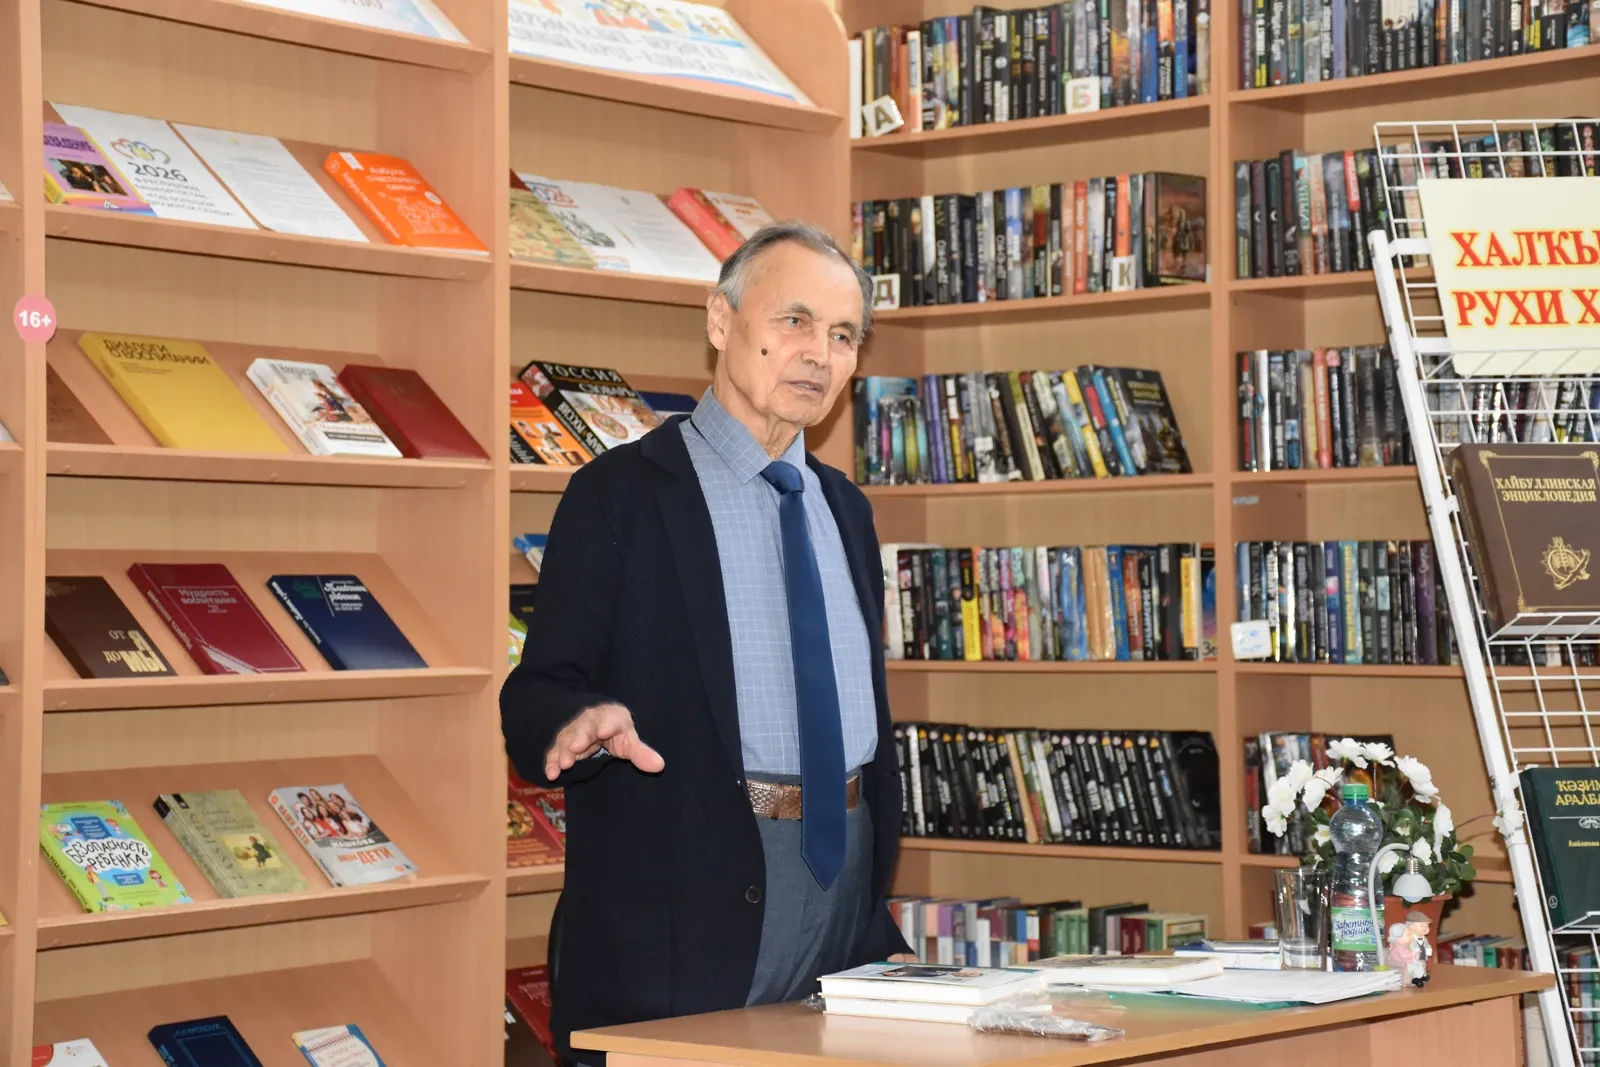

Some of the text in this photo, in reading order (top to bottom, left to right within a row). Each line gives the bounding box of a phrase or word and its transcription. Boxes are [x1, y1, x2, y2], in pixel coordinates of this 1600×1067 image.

[1071, 84, 1092, 109] Б
[874, 107, 894, 131] А
[127, 162, 188, 182] 2026
[1119, 262, 1135, 287] К
[874, 279, 896, 306] Д
[1451, 288, 1600, 326] РУХИ Х
[102, 339, 169, 354] ДИАЛОГИ
[121, 350, 210, 365] ВОСПИТАНИИ
[543, 362, 622, 383] РОССИЯ
[1495, 475, 1597, 490] ХАЙБУЛЛИНСКАЯ
[1502, 490, 1597, 503] ЭНЦИКЛОПЕДИЯ
[119, 650, 168, 673] МЫ
[1555, 793, 1600, 806] АРАЛБ
[65, 839, 149, 864] БЕЗОПАСНОСТЬ
[86, 852, 145, 871] РЕБЕНКА
[357, 847, 395, 866] ДЕТИ
[1341, 927, 1371, 939] родник
